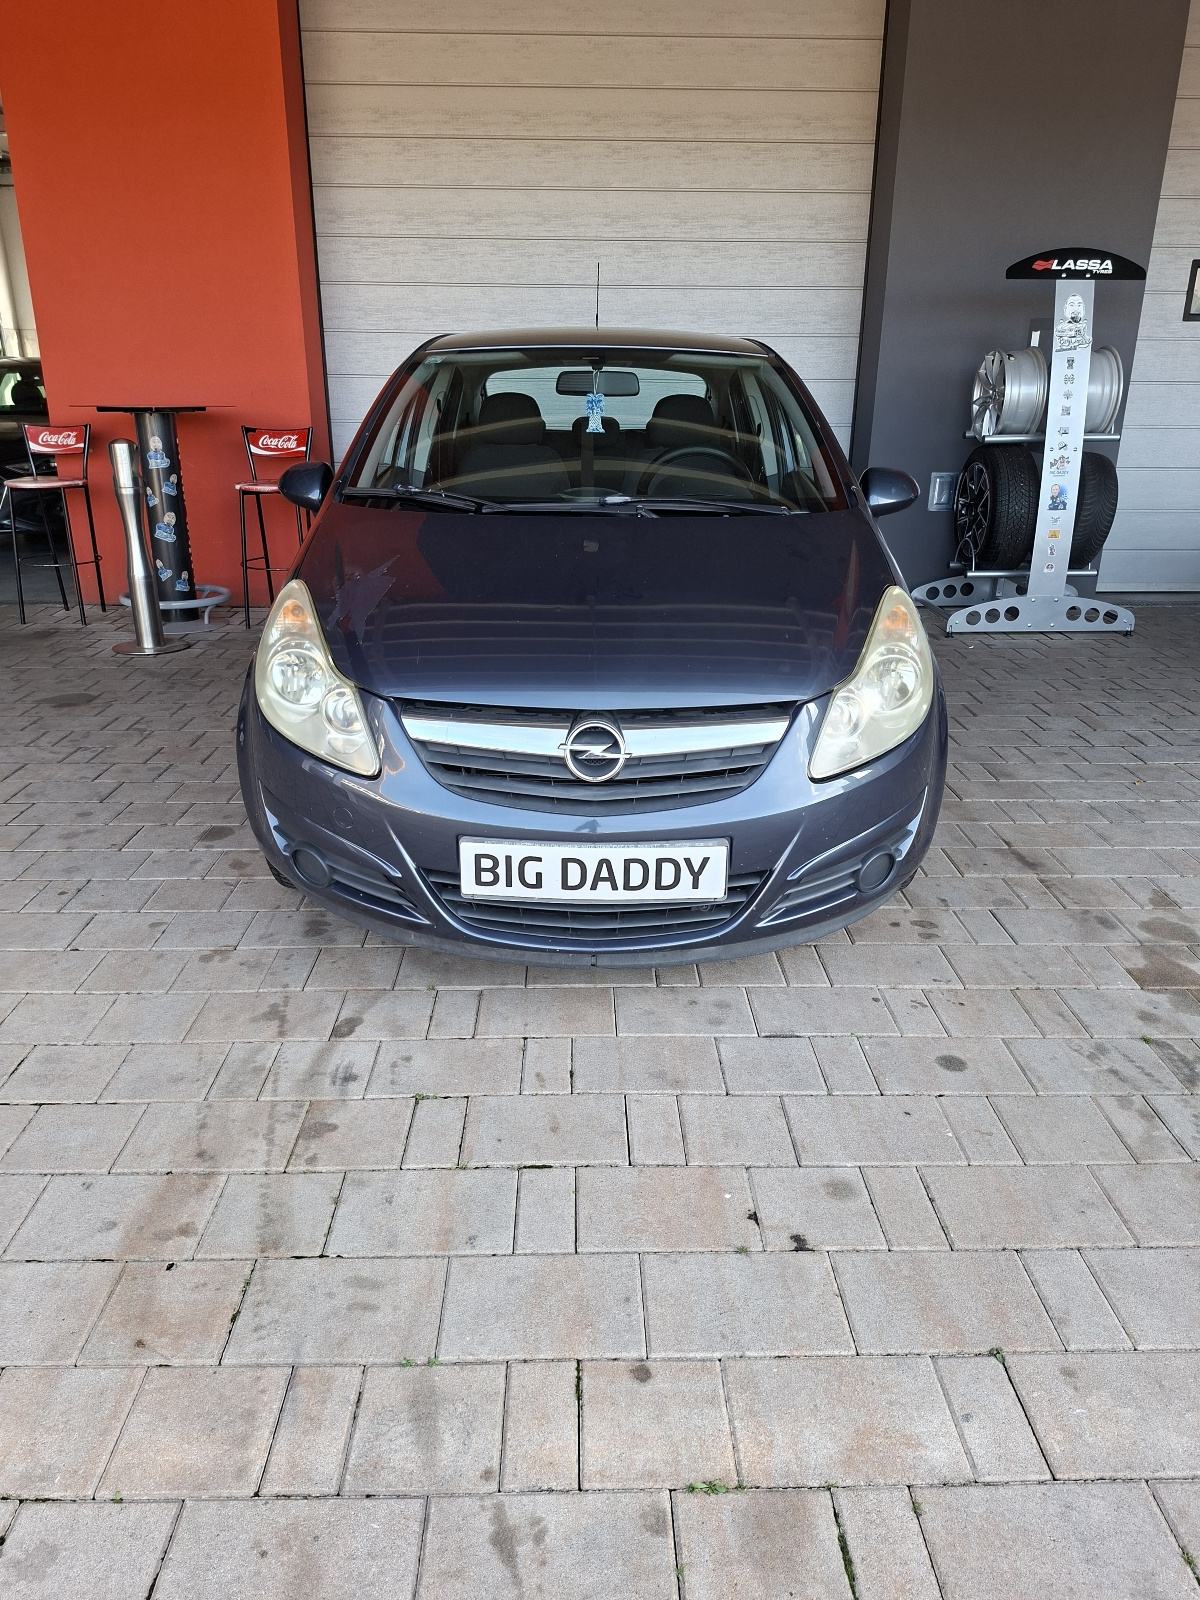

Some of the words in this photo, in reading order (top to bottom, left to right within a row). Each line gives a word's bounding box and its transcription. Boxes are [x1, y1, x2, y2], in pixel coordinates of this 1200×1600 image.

[1051, 259, 1113, 270] LASSA
[38, 431, 78, 445] Coca-Cola
[258, 434, 299, 449] Coca-Cola
[474, 853, 543, 889] BIG
[561, 857, 711, 891] DADDY
